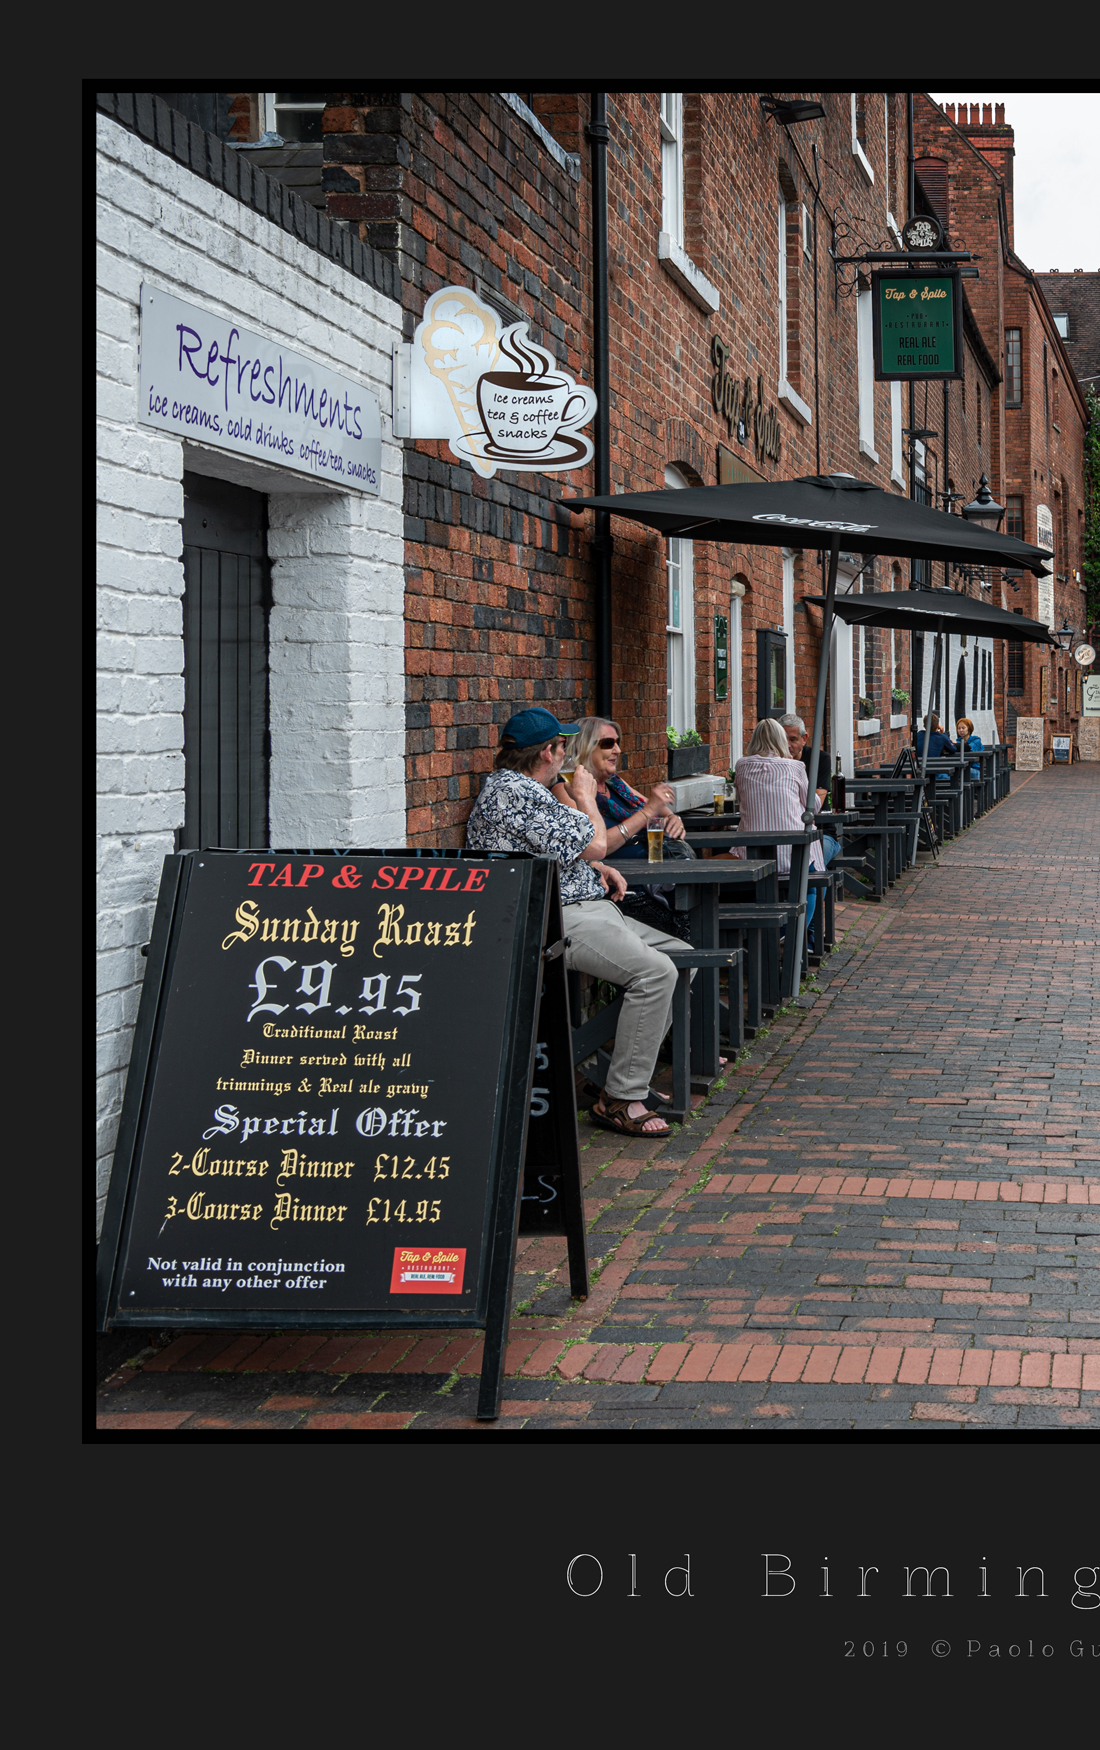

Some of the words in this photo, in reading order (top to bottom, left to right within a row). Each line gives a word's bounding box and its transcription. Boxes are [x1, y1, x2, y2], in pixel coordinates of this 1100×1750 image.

[914, 221, 932, 232] TAP
[885, 288, 906, 301] Tap
[909, 289, 918, 299] &
[920, 286, 948, 301] Spile
[899, 337, 920, 348] REAL
[922, 336, 936, 348] ALE
[897, 355, 916, 366] REAL
[918, 354, 940, 365] FOOD
[176, 323, 363, 440] Refreshments
[494, 393, 508, 404] Ice
[512, 394, 554, 405] creams
[713, 334, 740, 437] Tap
[755, 374, 782, 464] Spile
[488, 408, 506, 420] tea
[509, 412, 520, 424] &
[522, 409, 559, 425] coffee
[149, 385, 169, 418] ice
[172, 400, 224, 437] creams,
[227, 415, 253, 442] cold
[256, 422, 295, 456] drinks
[299, 439, 346, 476] coffee/tea,
[347, 459, 377, 485] snacks
[498, 428, 548, 439] snacks
[248, 863, 324, 888] TAP
[332, 865, 363, 888] &
[372, 866, 490, 892] SPILE
[222, 900, 360, 958] Sunday
[373, 903, 477, 958] Roast
[246, 956, 422, 1022] £9.95
[262, 1022, 347, 1040] Traditional
[352, 1024, 398, 1044] Roast
[240, 1048, 294, 1069] Dinner
[299, 1052, 348, 1066] served
[354, 1052, 386, 1071] with
[392, 1053, 412, 1068] all
[216, 1077, 292, 1096] trimmings
[298, 1078, 312, 1092] &
[318, 1077, 354, 1097] Real
[358, 1079, 380, 1094] ale
[386, 1082, 429, 1100] gravy
[202, 1104, 340, 1144] Special
[355, 1106, 448, 1138] Offer
[168, 1147, 270, 1177] 2-Course
[276, 1148, 356, 1187] Dinner
[373, 1154, 451, 1182] £12.45
[164, 1192, 264, 1221] 3-Course
[270, 1192, 348, 1231] Dinner
[366, 1197, 442, 1226] £14.95
[146, 1256, 178, 1272] Not
[182, 1257, 222, 1272] valid
[226, 1258, 243, 1272] in
[248, 1258, 346, 1276] conjunction
[400, 1250, 421, 1264] Tap
[422, 1252, 432, 1262] &
[432, 1251, 460, 1264] Spile
[162, 1274, 198, 1290] with
[202, 1277, 232, 1292] any
[236, 1275, 280, 1290] other
[285, 1275, 327, 1290] offer
